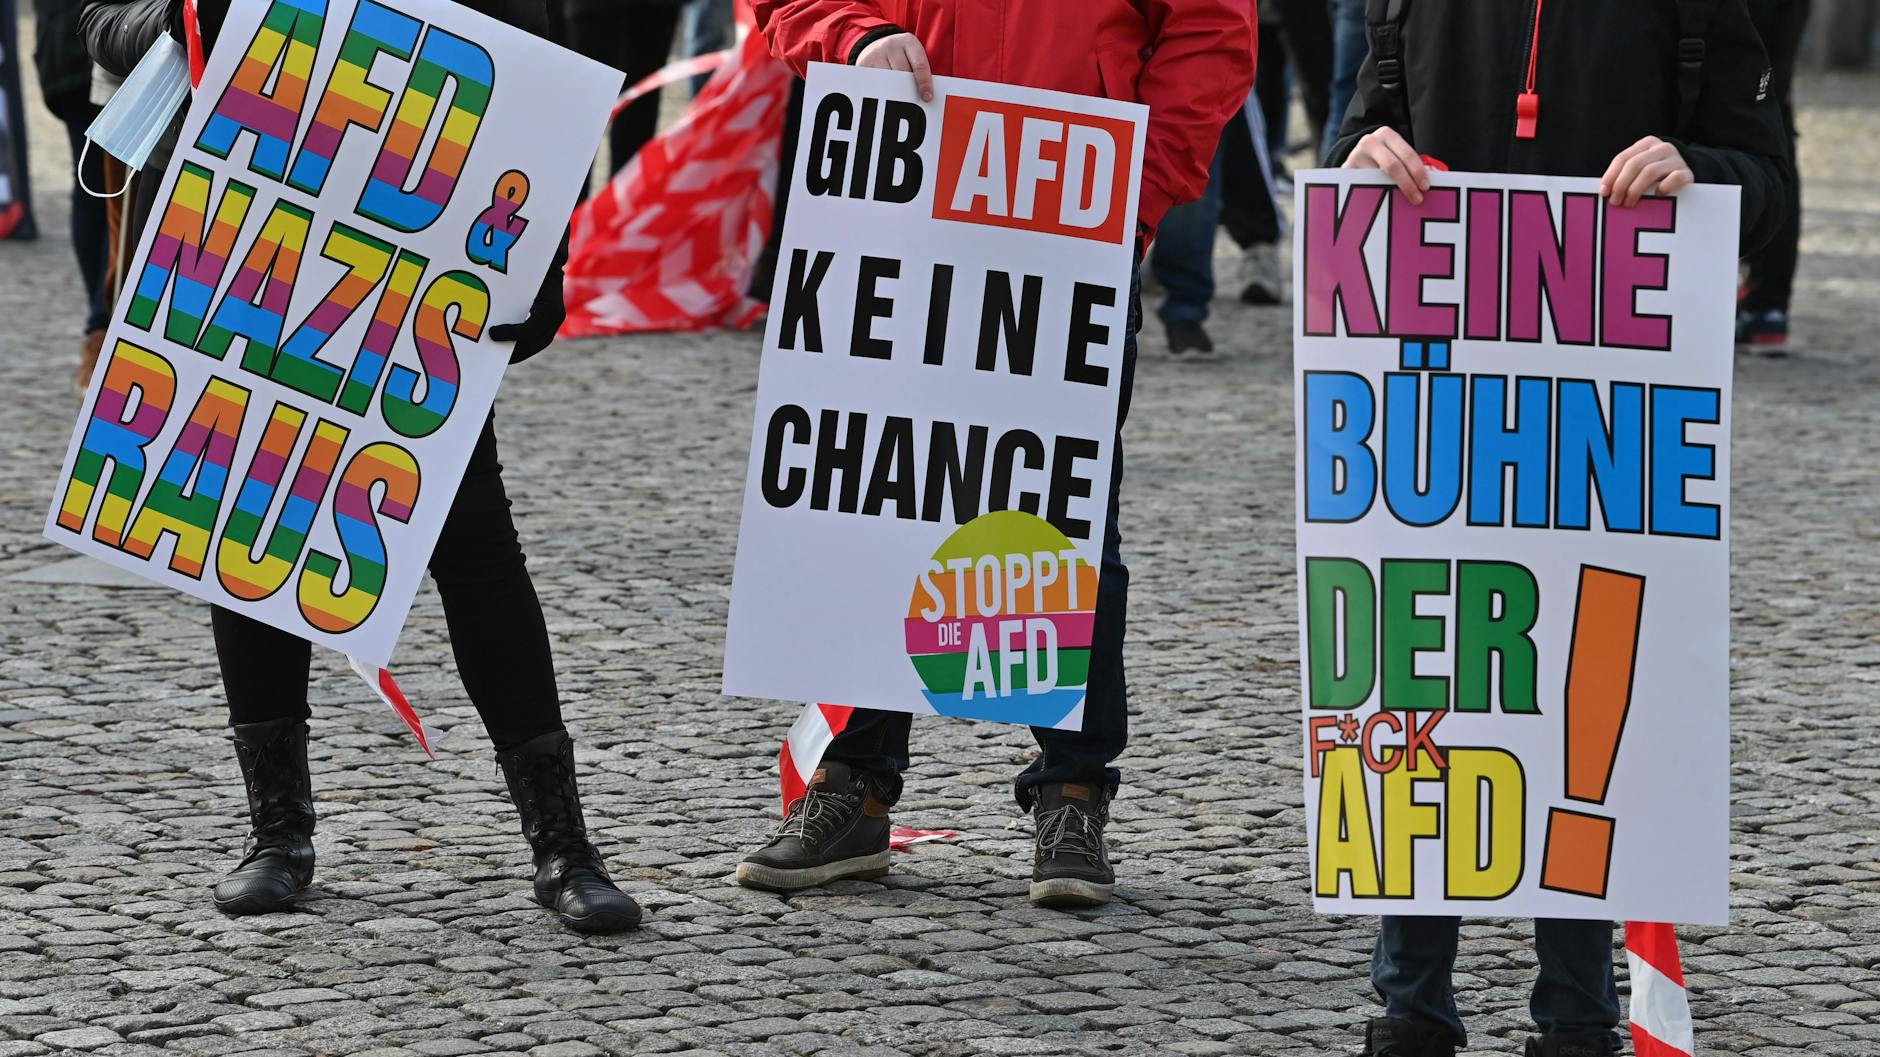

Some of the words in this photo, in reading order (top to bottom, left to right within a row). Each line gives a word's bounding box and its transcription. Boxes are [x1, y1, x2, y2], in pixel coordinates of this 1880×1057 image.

[194, 0, 495, 233] AFD
[466, 169, 530, 274] &
[806, 92, 927, 204] GIB
[950, 110, 1116, 229] AFD
[124, 159, 491, 439] NAZIS
[777, 248, 1117, 387] KEINE
[1303, 183, 1677, 351] KEINE
[56, 337, 421, 635] RAUS
[761, 404, 1099, 540] CHANCE
[1303, 339, 1721, 540] BÜHNE
[920, 548, 1084, 624] STOPPT
[938, 622, 962, 646] DIE
[962, 617, 1059, 700] AFD
[1305, 556, 1543, 715] DER
[1539, 563, 1646, 900] !
[1315, 744, 1526, 901] AFD
